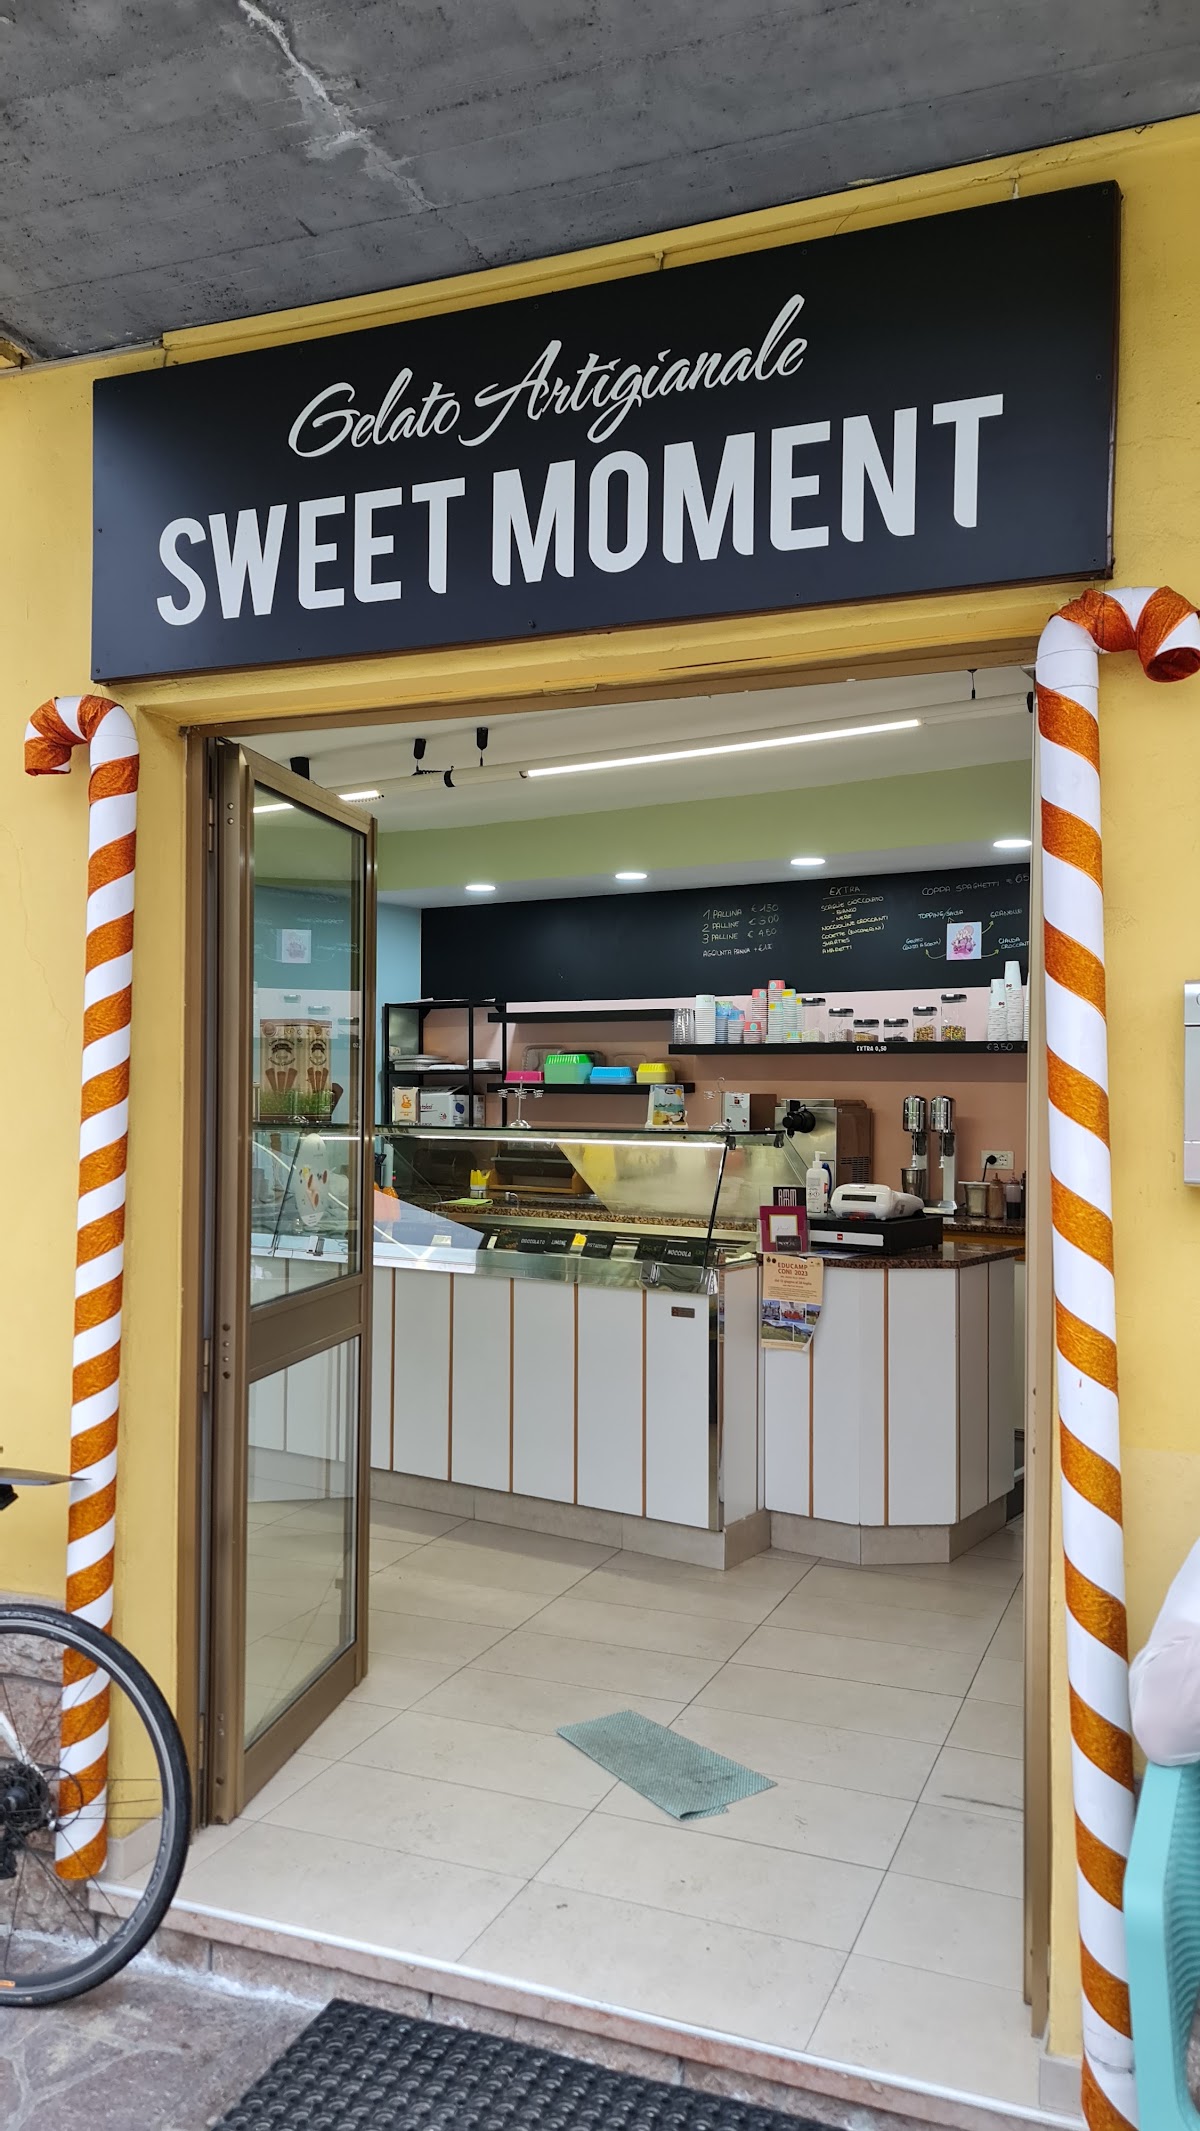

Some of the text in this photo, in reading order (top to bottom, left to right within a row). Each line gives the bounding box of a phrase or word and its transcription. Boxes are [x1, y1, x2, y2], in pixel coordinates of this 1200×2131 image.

[288, 294, 808, 458] Gelato Artigianale
[156, 393, 1005, 627] SWEET MOMENT
[829, 886, 861, 896] EXTRA
[921, 885, 951, 896] COPPA
[955, 881, 1000, 892] SPAGHETTI
[712, 908, 742, 919] PALLINA
[701, 923, 710, 933] 2
[711, 920, 740, 930] PALLINE
[701, 933, 709, 945] 3
[711, 932, 739, 942] PALLINE
[821, 944, 853, 954] AMARETTI
[1000, 941, 1030, 950] CROCCANT
[667, 1249, 692, 1257] NOCCIOLA
[777, 1262, 808, 1270] EDUCAMP
